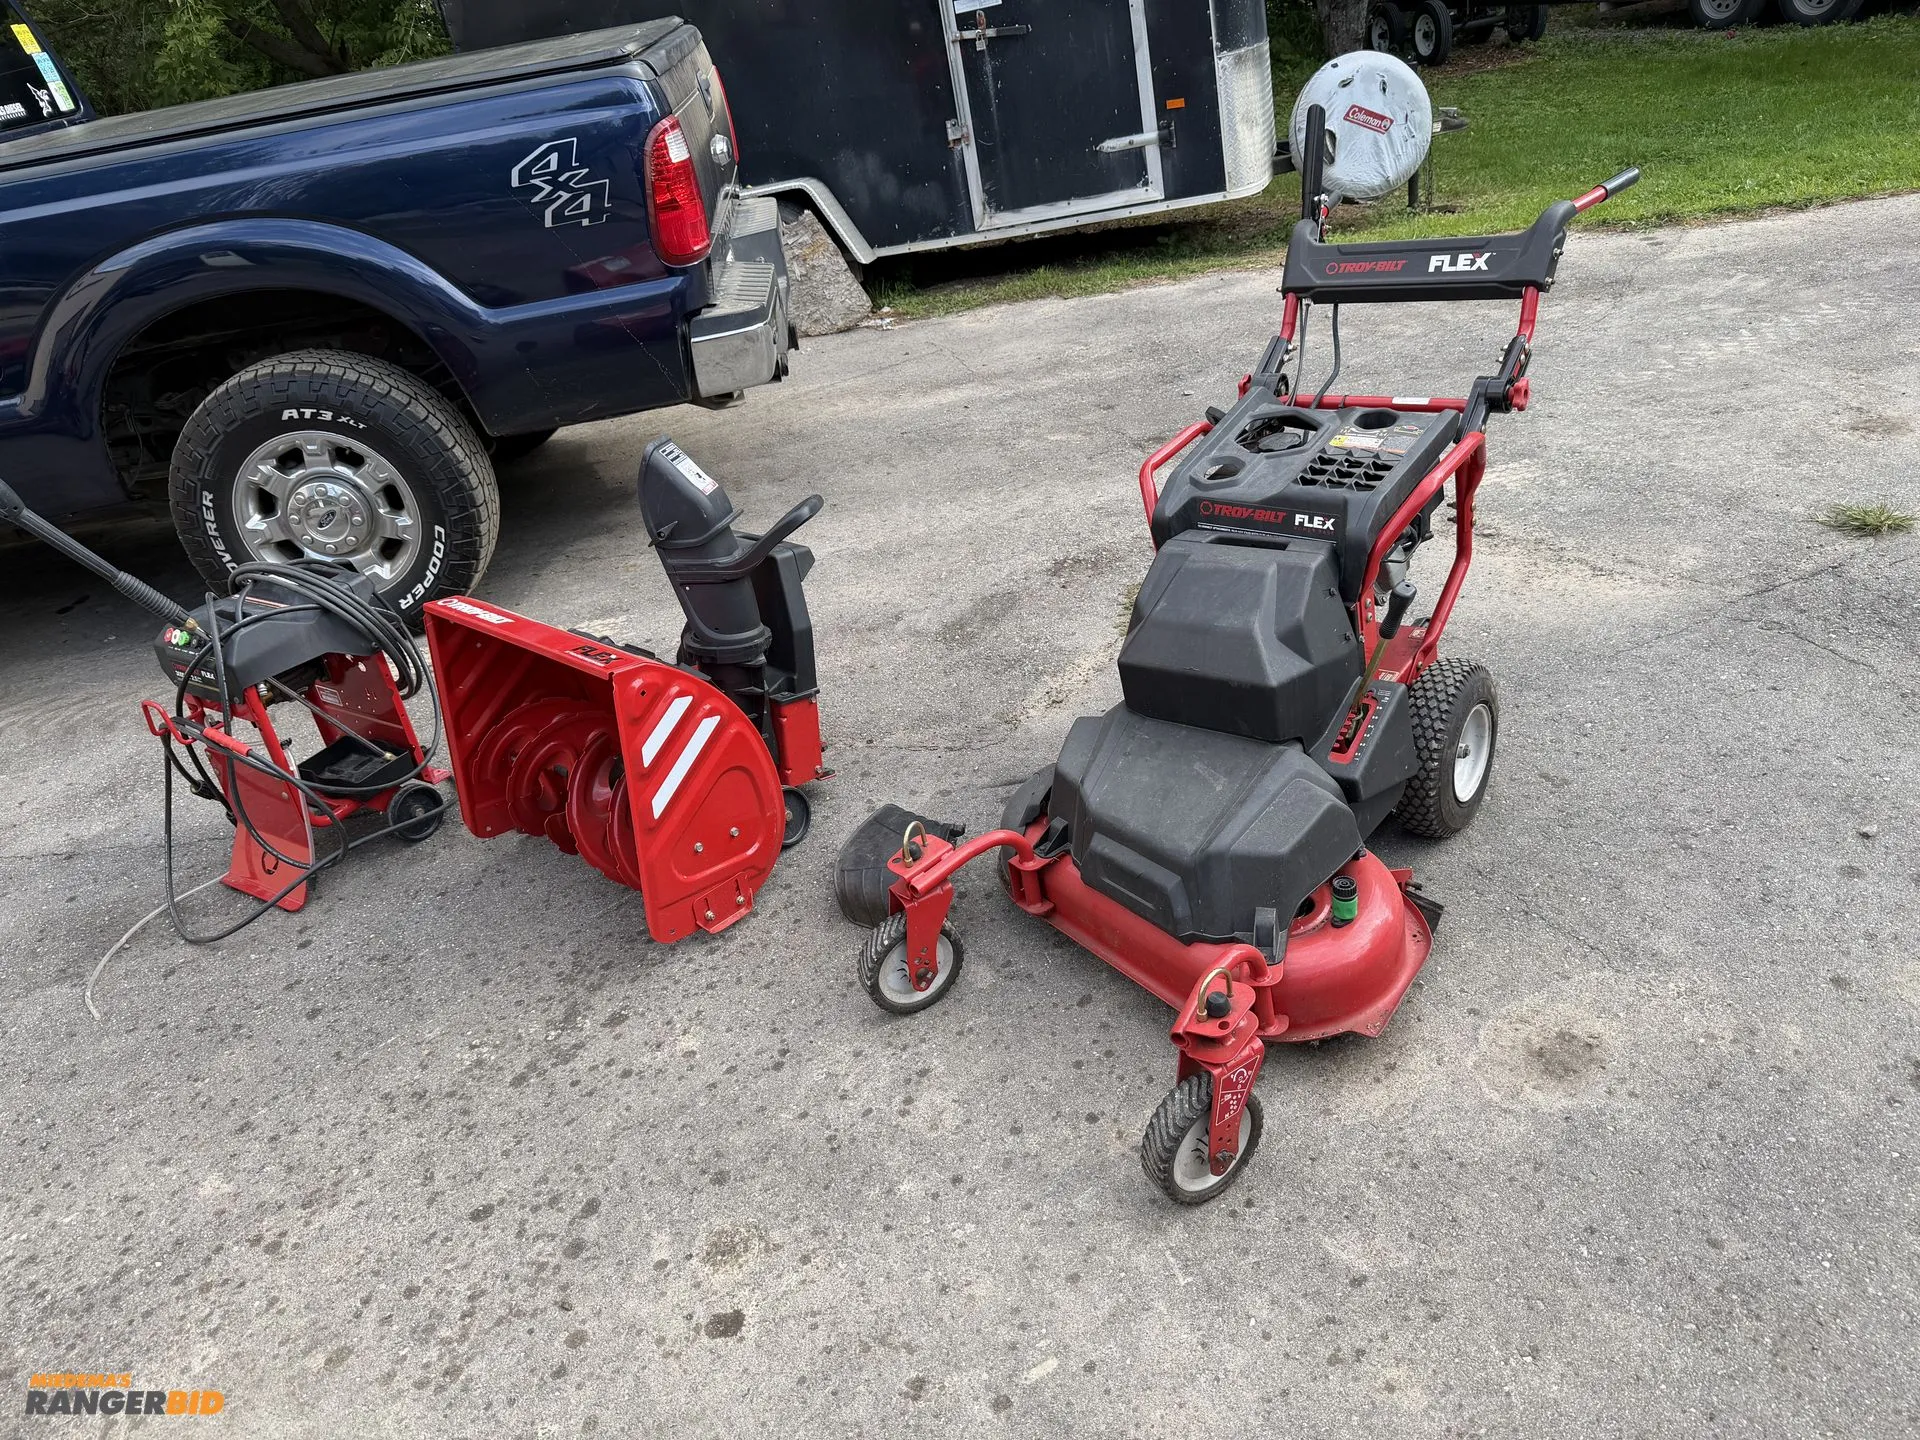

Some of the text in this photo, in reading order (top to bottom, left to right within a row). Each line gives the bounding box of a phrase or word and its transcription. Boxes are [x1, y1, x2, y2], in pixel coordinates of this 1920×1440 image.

[1349, 107, 1381, 128] Coleman
[1339, 252, 1491, 273] TROY-BILT FLEX
[281, 408, 367, 429] AT3 XLT
[1213, 503, 1287, 524] TROY-BILT
[1294, 513, 1336, 531] FLEX
[202, 490, 239, 574] OVERER
[398, 525, 446, 610] COOPER
[449, 602, 516, 625] TROY-BILT
[570, 645, 624, 665] FLEX
